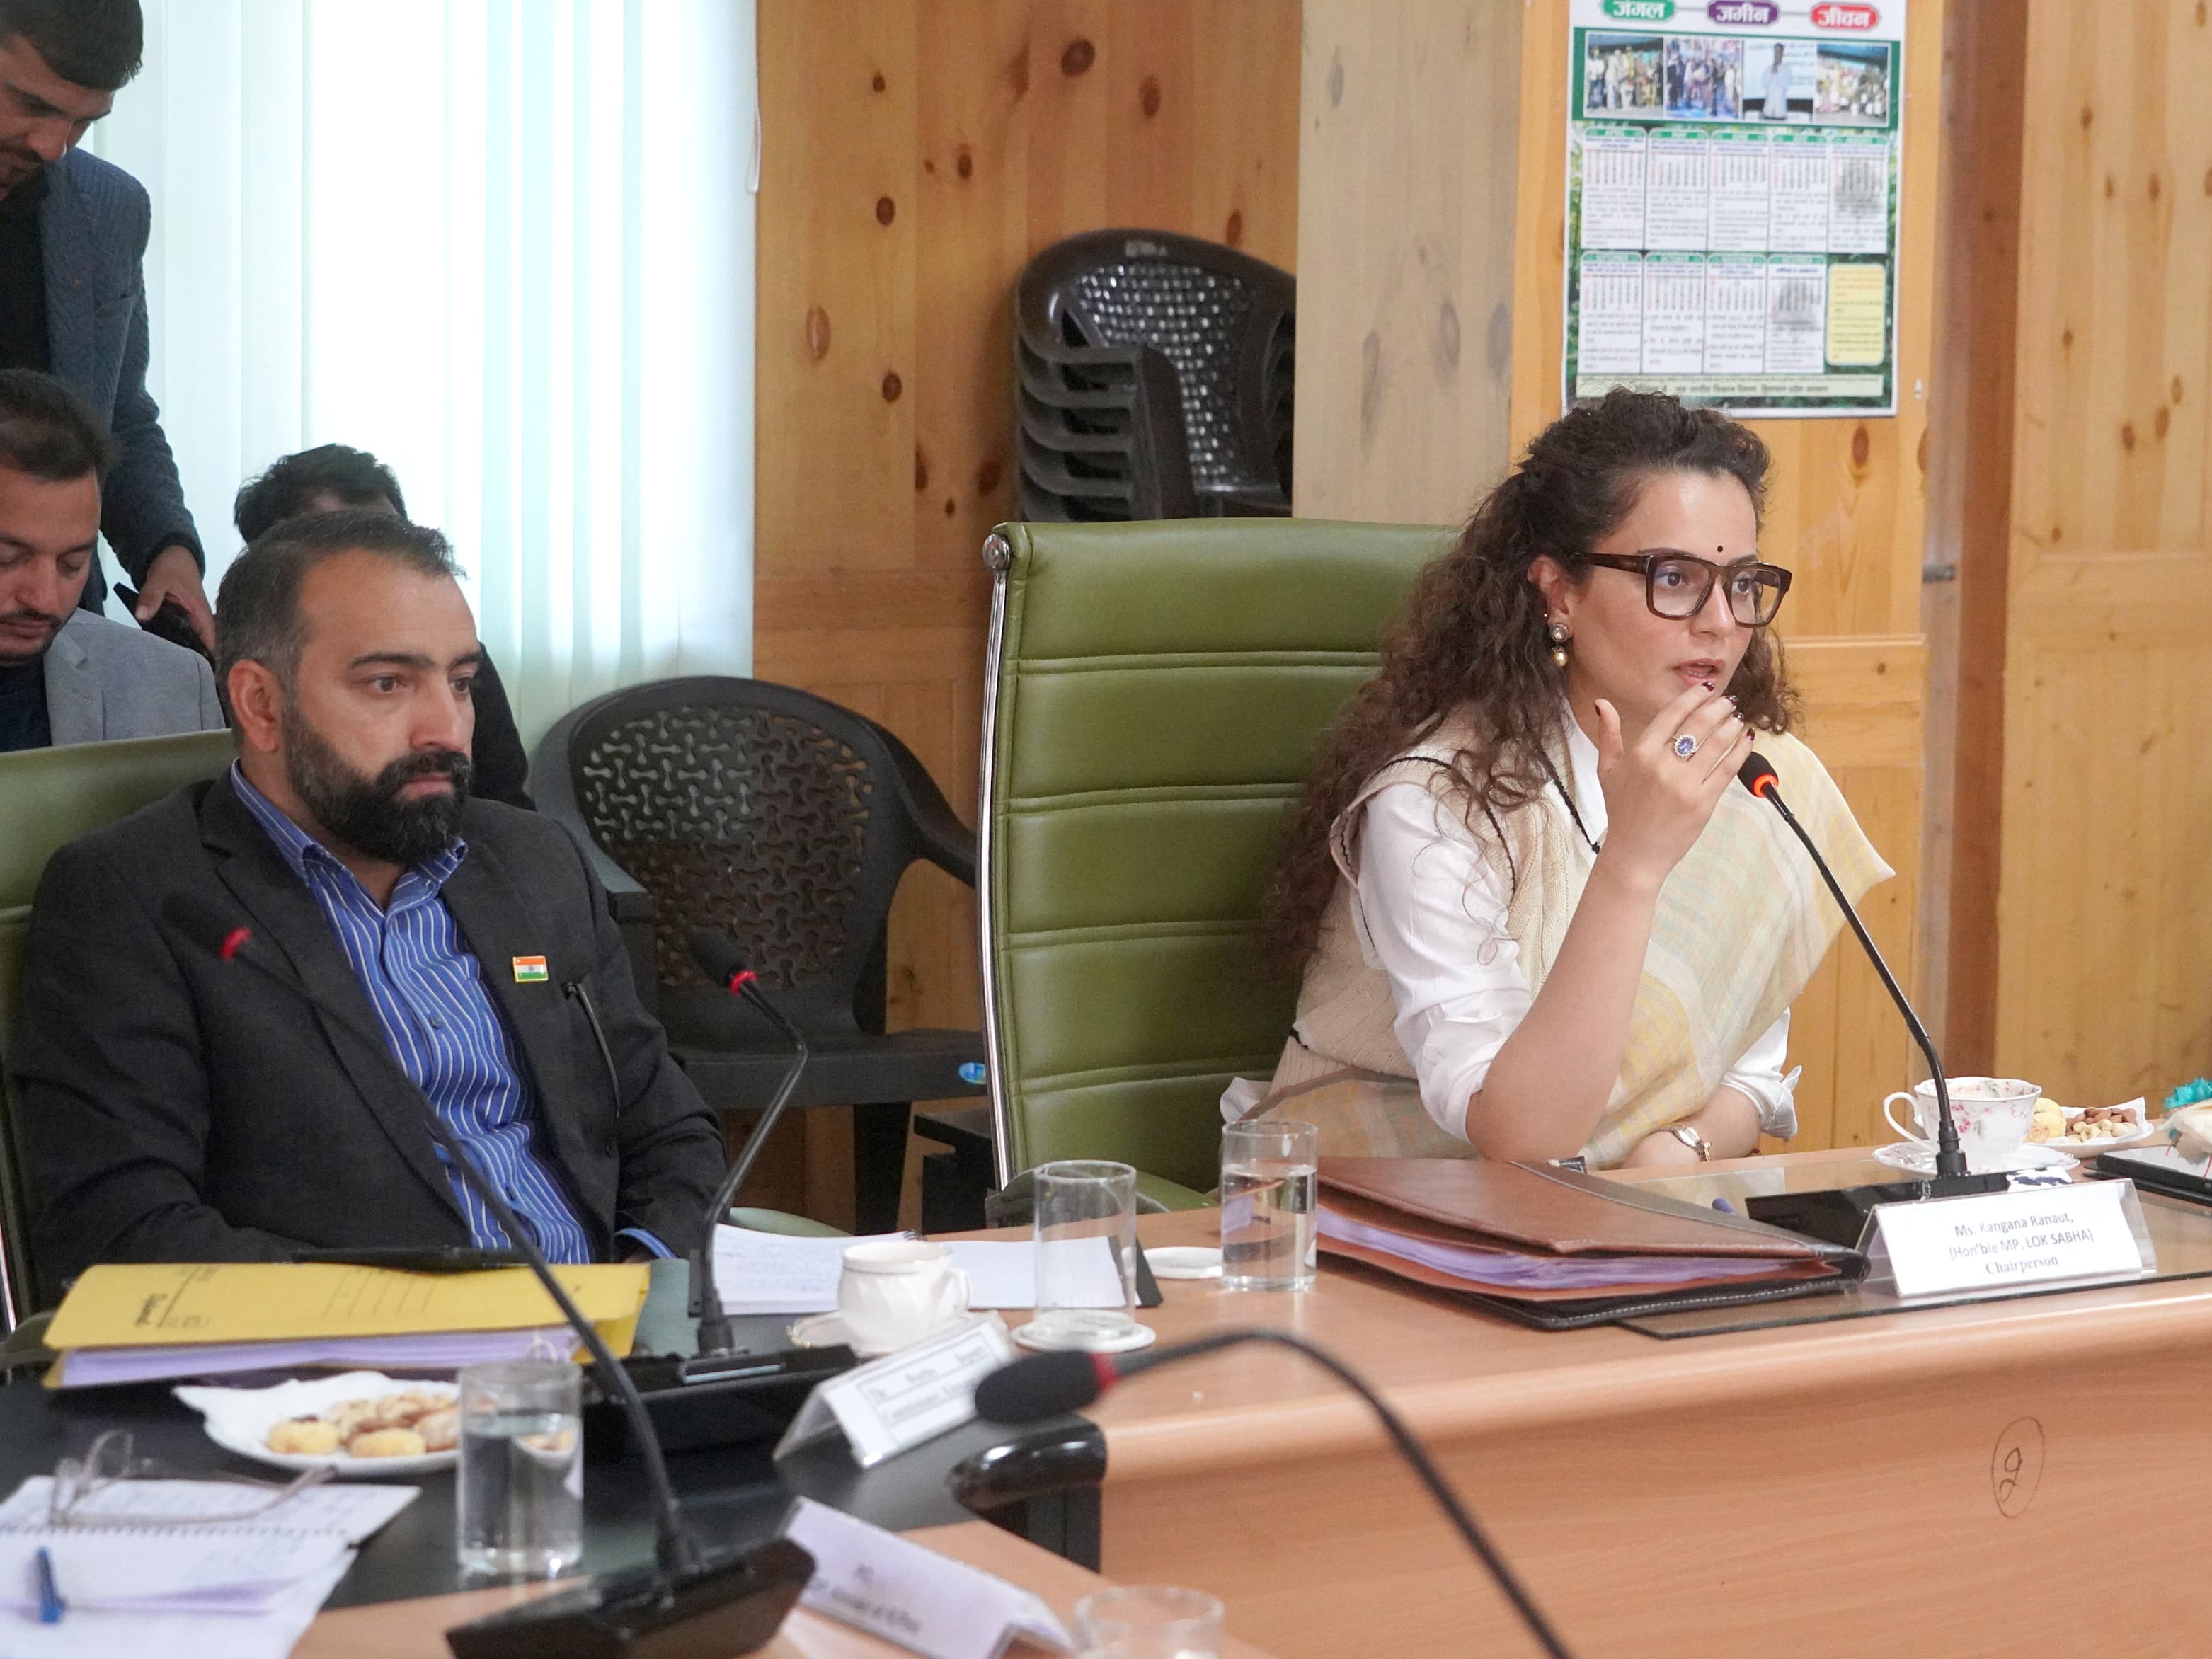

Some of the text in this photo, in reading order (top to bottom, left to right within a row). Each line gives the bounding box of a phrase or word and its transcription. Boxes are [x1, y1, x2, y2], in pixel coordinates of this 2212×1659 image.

[1716, 3, 1769, 23] जमीन
[1818, 5, 1869, 28] जीवन
[1954, 1212, 2073, 1237] Ms. Kangana Ranaut,
[2025, 1235, 2050, 1248] LOK
[2051, 1228, 2094, 1245] SABHA)
[1985, 1256, 2058, 1275] Chairperson
